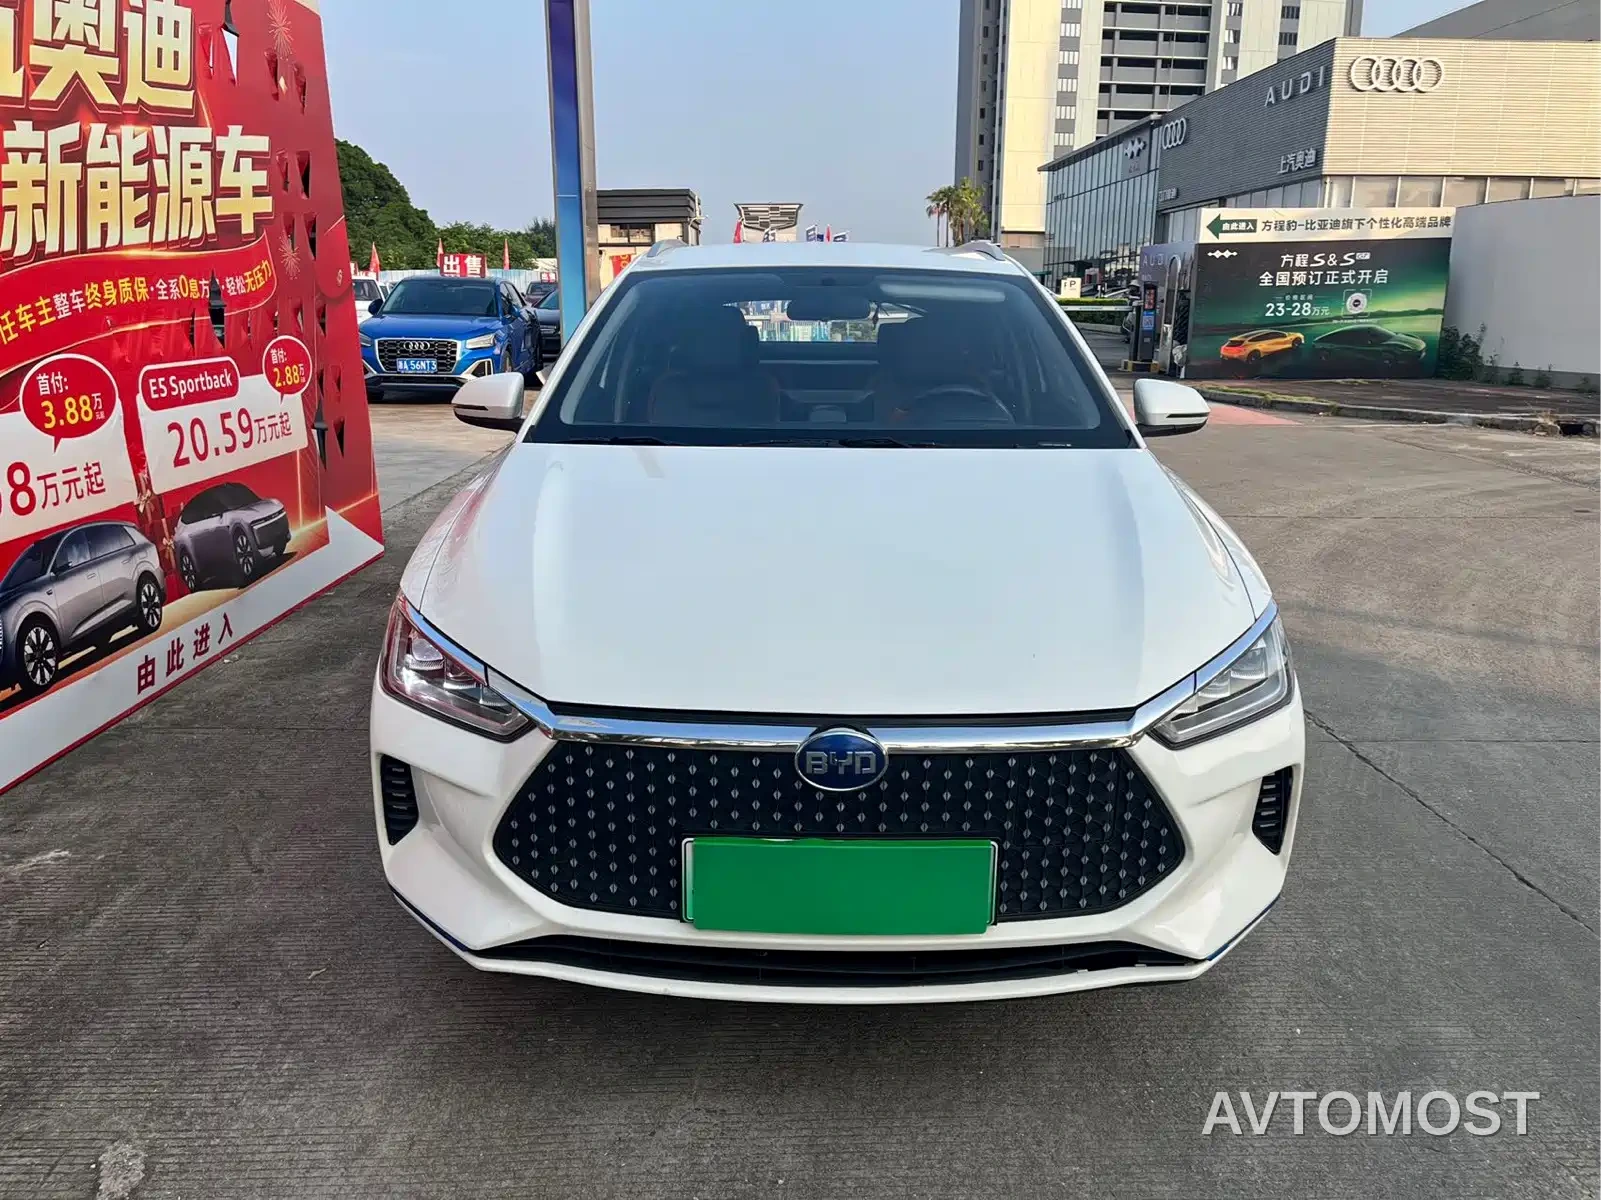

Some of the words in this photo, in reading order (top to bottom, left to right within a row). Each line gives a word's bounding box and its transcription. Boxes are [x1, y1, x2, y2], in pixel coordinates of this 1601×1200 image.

[1263, 65, 1325, 107] AUDI
[1277, 147, 1317, 174] 上汽奥迪
[1, 120, 273, 256] 新能源车
[1222, 221, 1255, 231] 由此进入
[443, 254, 482, 275] 出售
[1259, 269, 1389, 287] 全国预订正式开启
[149, 377, 168, 399] E5
[172, 369, 233, 401] Sportback
[0, 461, 106, 517] 8万元起
[137, 612, 234, 695] 由此进入
[806, 751, 876, 774] BYD
